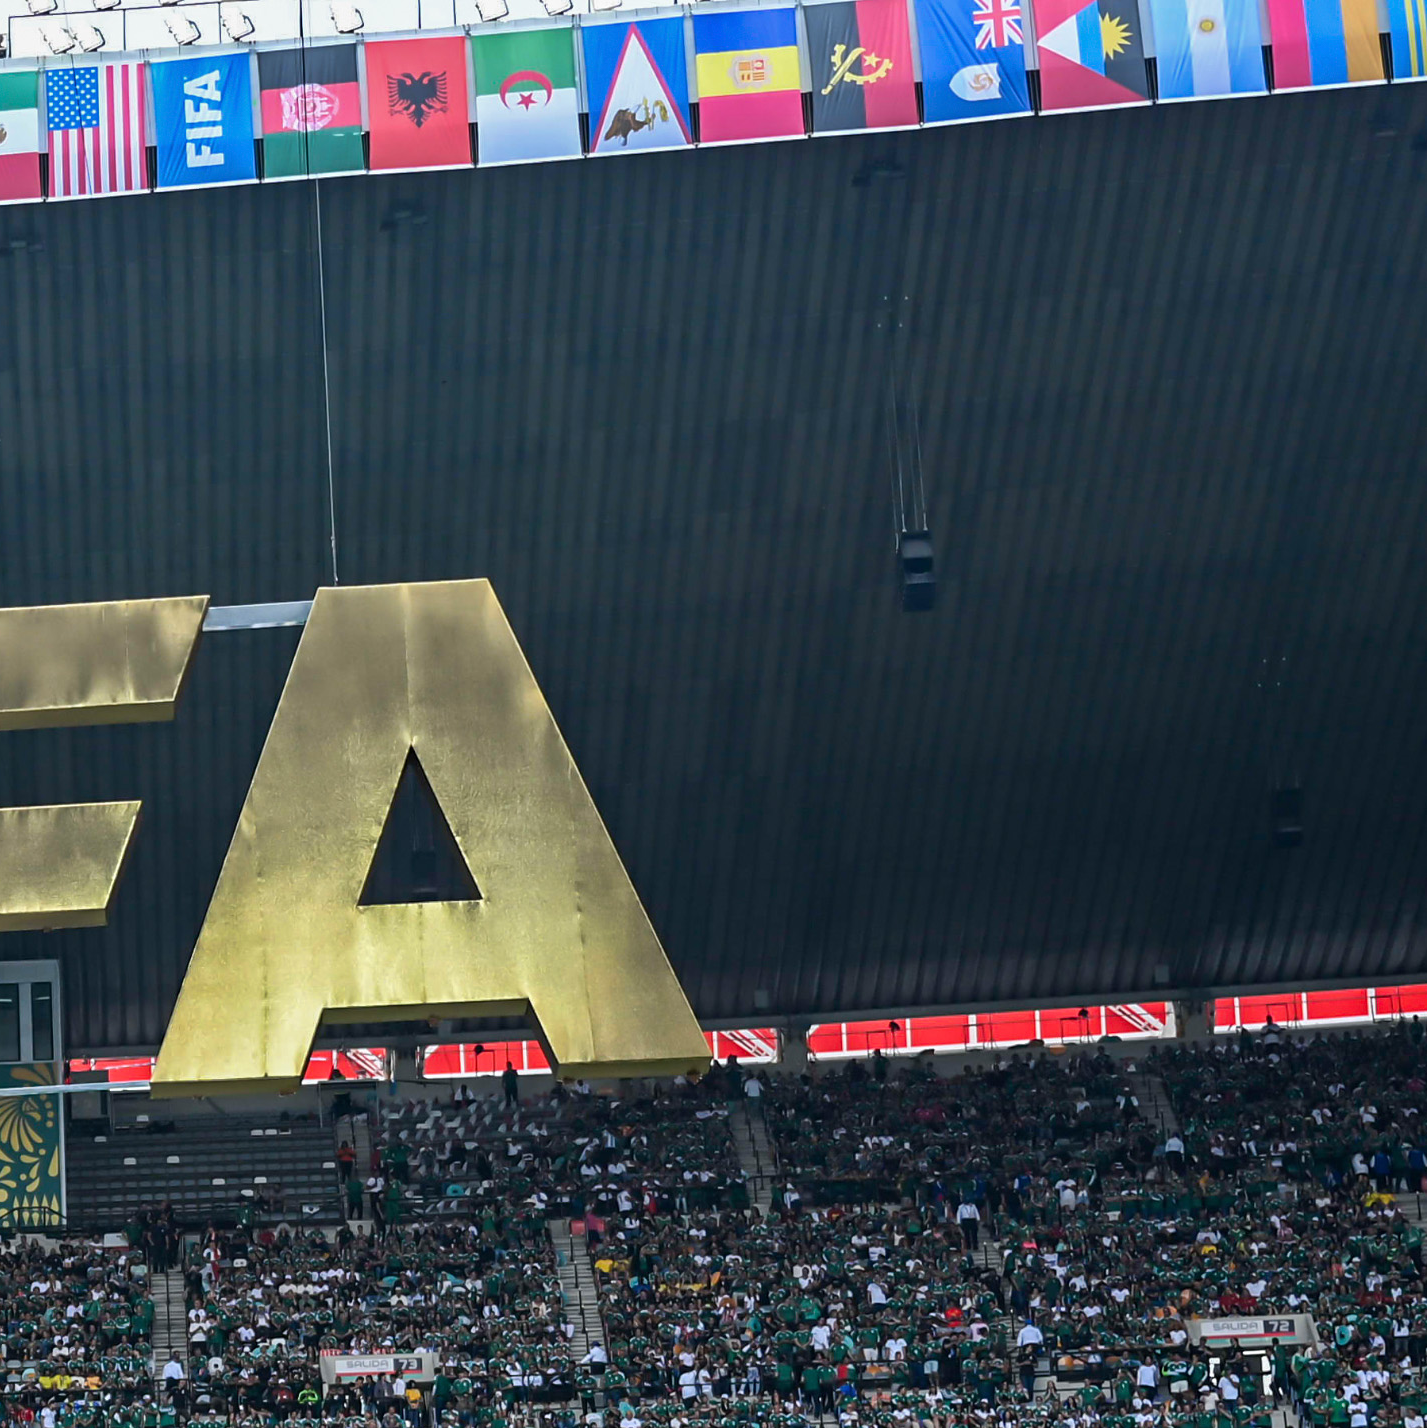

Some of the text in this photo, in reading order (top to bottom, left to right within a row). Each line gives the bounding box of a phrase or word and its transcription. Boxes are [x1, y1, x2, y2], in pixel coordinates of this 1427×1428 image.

[183, 69, 224, 168] FIFA
[1268, 1322, 1291, 1333] 72
[346, 1359, 419, 1371] SALIDA 73
